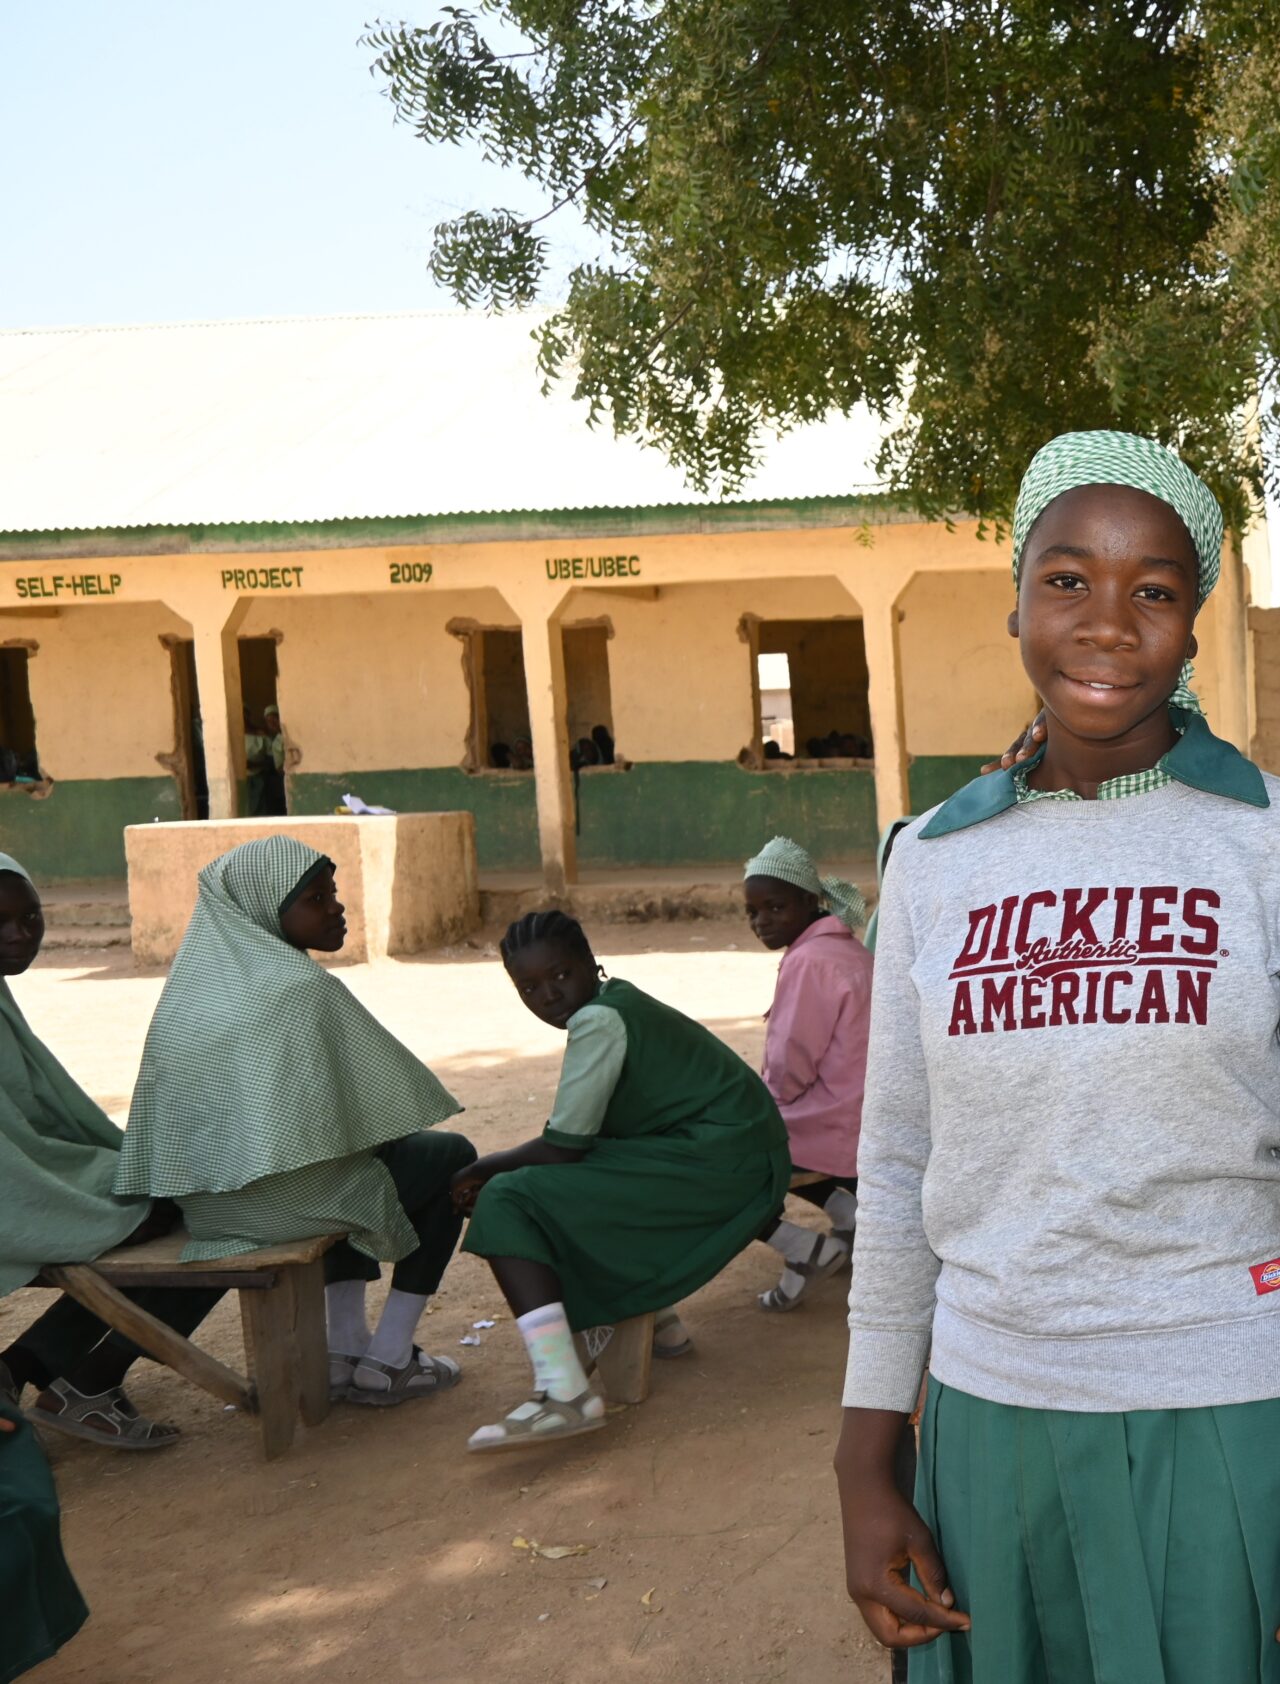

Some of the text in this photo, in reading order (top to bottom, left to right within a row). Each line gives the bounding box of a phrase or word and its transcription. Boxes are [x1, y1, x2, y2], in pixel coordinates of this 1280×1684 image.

[15, 555, 641, 599] SELF-HELP PROJECT 2009 UBE/UBEC
[953, 886, 1221, 970] DICKIES
[1015, 936, 1139, 970] Authentic
[948, 969, 1212, 1037] AMERICAN
